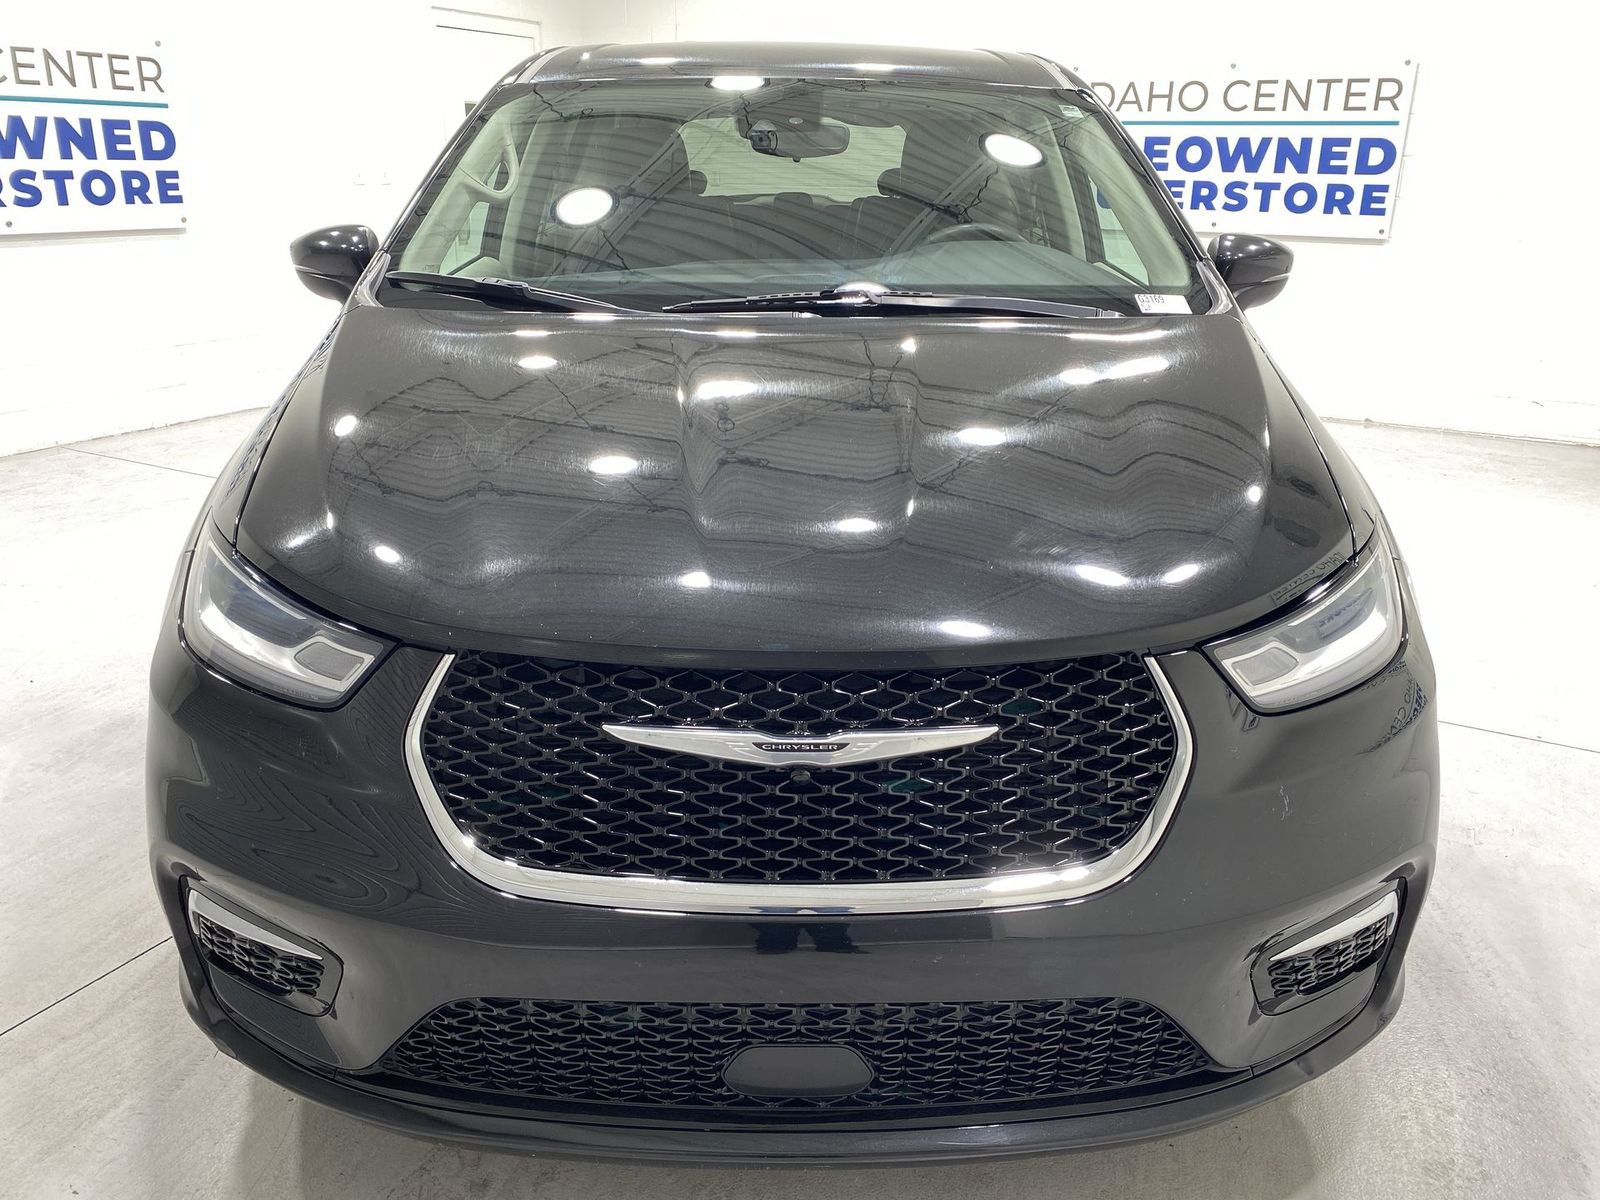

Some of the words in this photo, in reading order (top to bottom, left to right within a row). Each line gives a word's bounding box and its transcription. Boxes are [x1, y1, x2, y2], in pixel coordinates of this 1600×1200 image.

[0, 46, 165, 93] ENTER
[1222, 78, 1404, 113] CENTER
[0, 169, 184, 207] STORE
